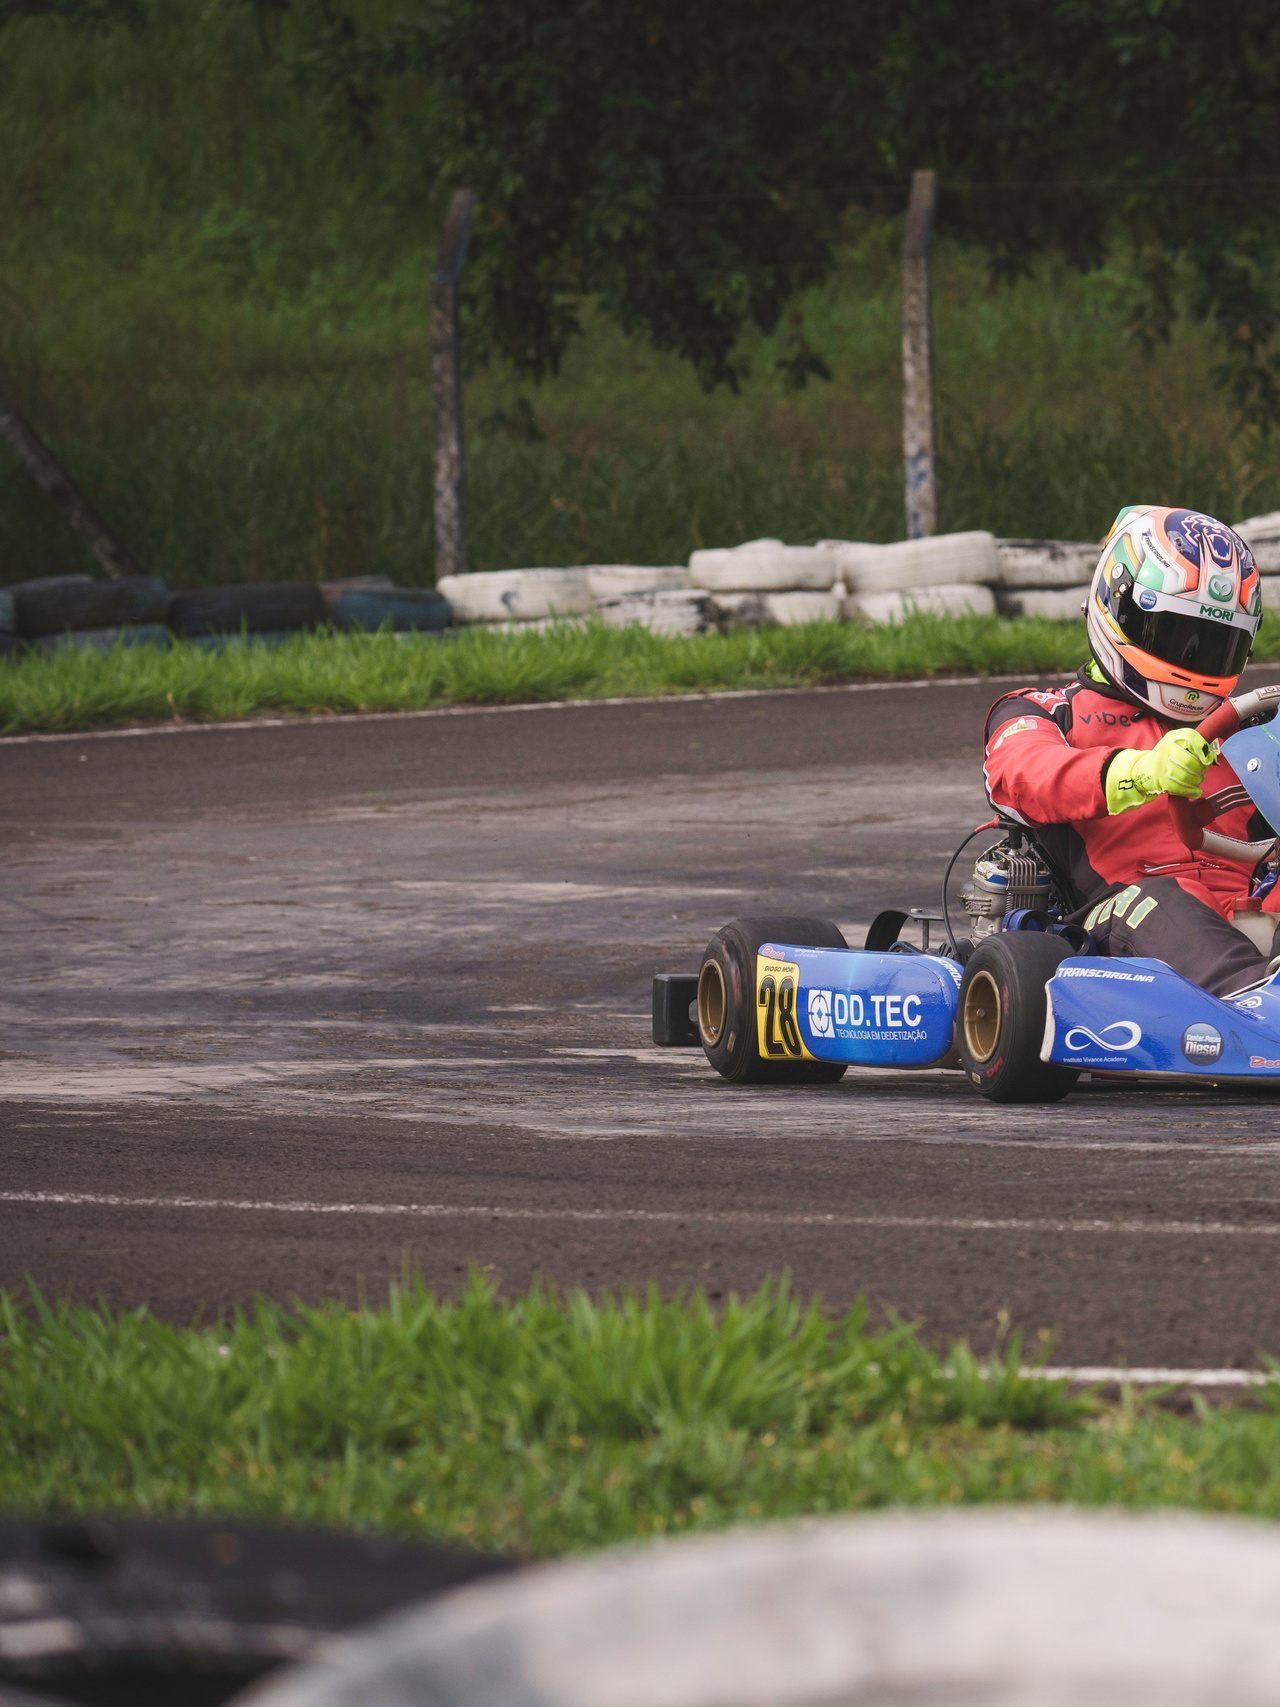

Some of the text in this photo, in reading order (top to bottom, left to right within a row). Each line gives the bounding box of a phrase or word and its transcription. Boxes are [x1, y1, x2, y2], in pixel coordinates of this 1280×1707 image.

[1200, 604, 1234, 621] MORI
[1057, 967, 1156, 983] TRANSCAROLINA
[759, 975, 803, 1057] 28
[834, 993, 922, 1027] DD.TEC
[836, 1029, 927, 1042] TECNOLOGIA EM DEDETIZAÇÃO
[1185, 1041, 1221, 1056] Diesel
